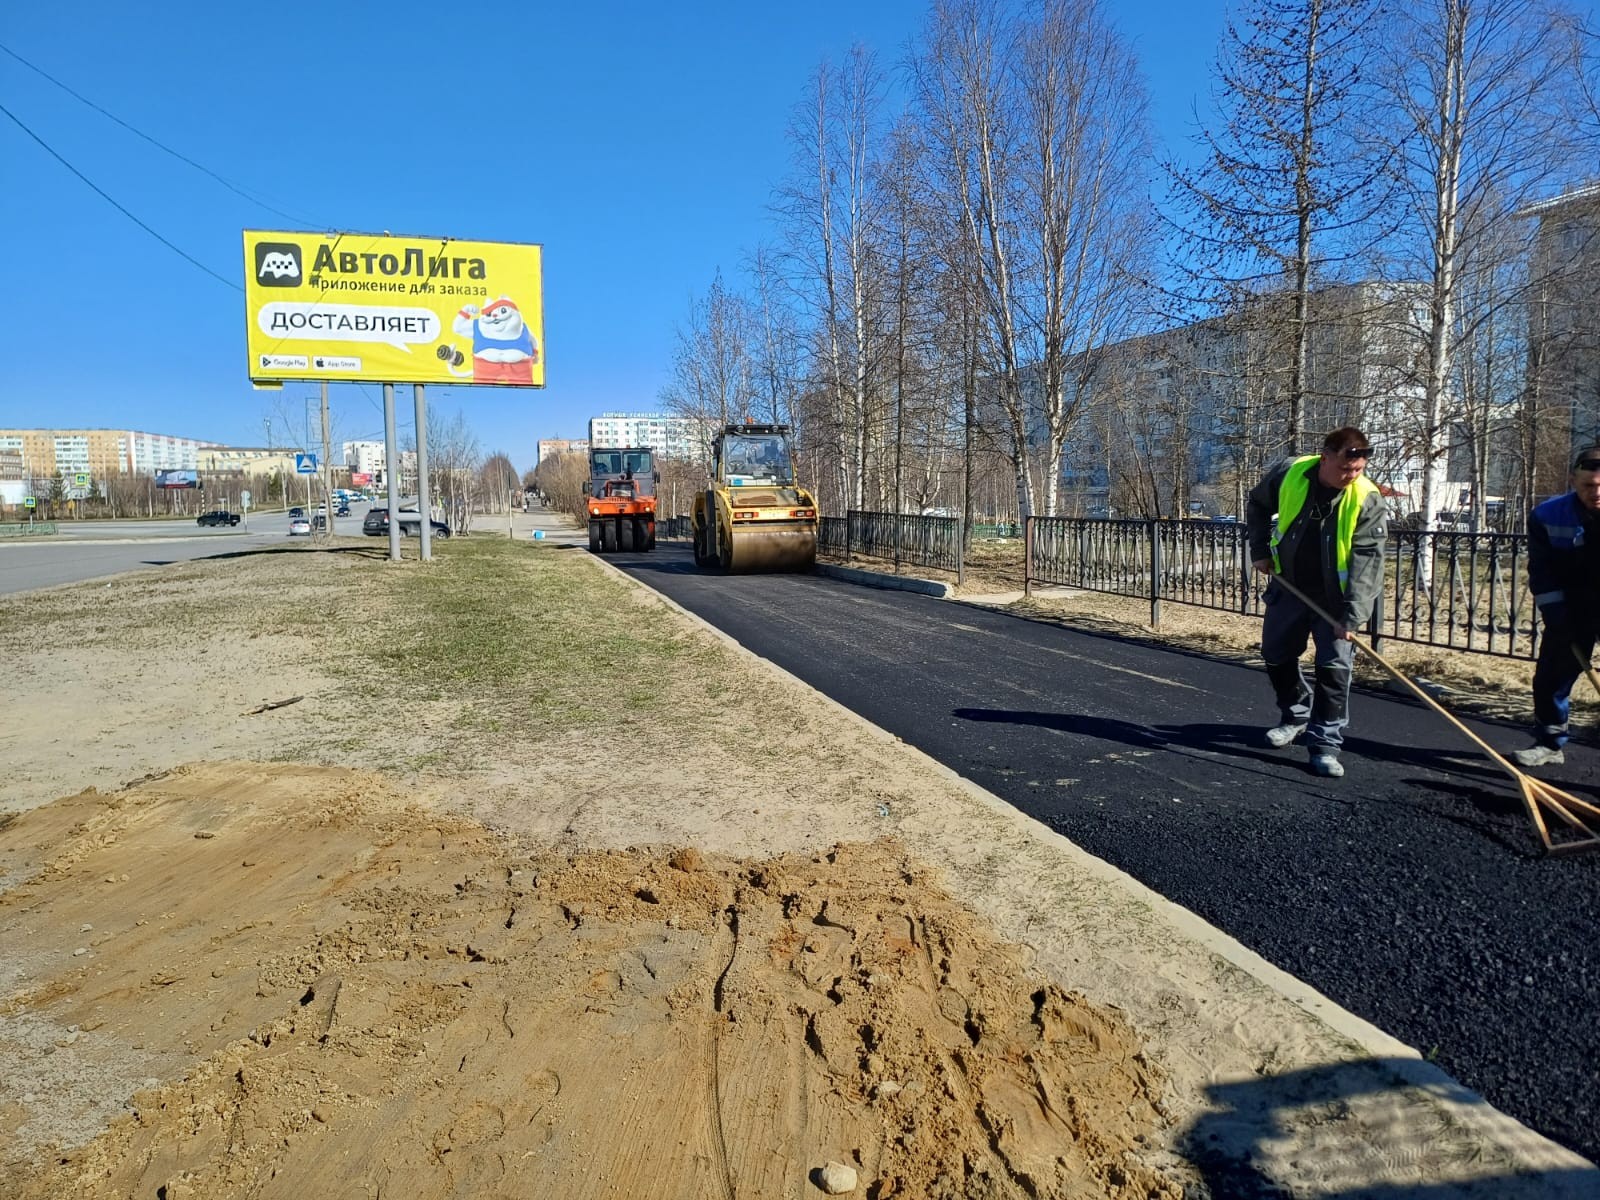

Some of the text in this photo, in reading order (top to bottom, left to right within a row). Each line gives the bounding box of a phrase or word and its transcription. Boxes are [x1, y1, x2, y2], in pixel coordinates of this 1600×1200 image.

[312, 244, 486, 280] АвтоЛига
[409, 284, 435, 295] для
[440, 284, 487, 296] заказа
[271, 312, 430, 333] ДОСТАВЛЯЕТ
[273, 359, 306, 367] Google Play
